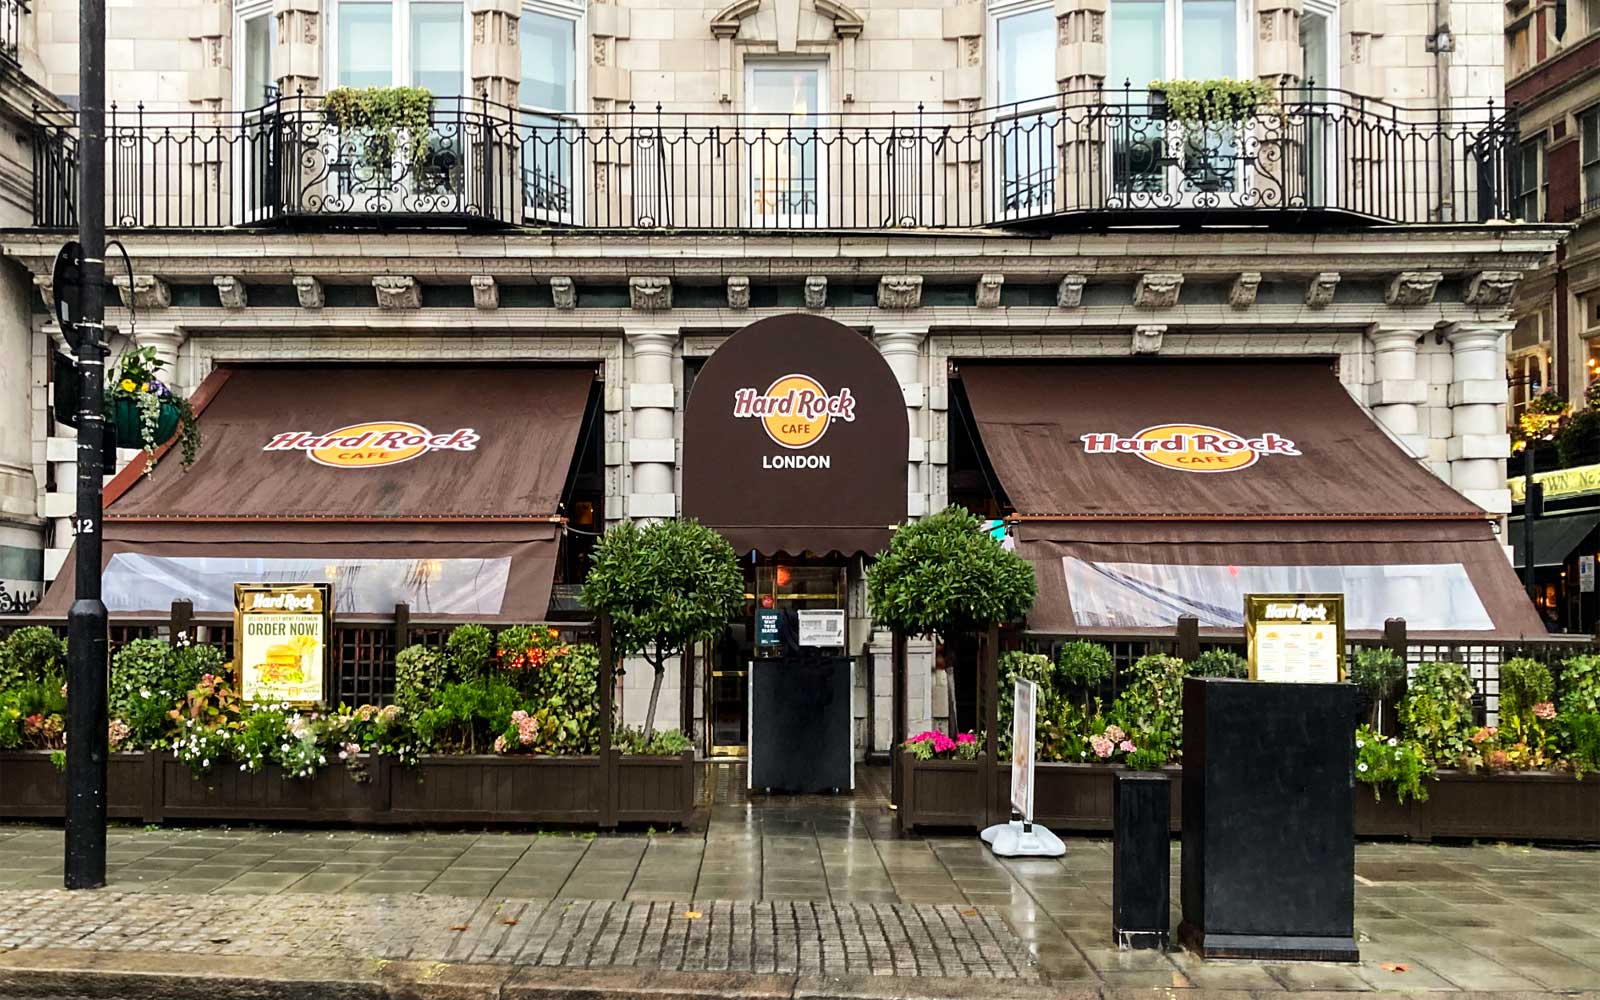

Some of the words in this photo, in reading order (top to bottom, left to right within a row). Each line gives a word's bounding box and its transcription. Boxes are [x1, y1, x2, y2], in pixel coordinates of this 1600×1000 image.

[734, 388, 797, 418] Hard
[797, 388, 856, 422] Rock
[781, 424, 811, 434] CAFE
[264, 432, 375, 451] Hard
[372, 428, 481, 451] Rock
[1080, 433, 1190, 453] Hard
[1190, 433, 1303, 456] Rock
[337, 451, 390, 461] CAFE
[762, 455, 831, 469] LONDON
[1175, 455, 1231, 465] CAFE
[252, 593, 285, 608] Hard
[284, 593, 315, 611] Rock
[1264, 603, 1298, 619] Hard
[1297, 603, 1328, 622] Rock
[248, 623, 286, 636] ORDER
[290, 623, 319, 636] NOW!
